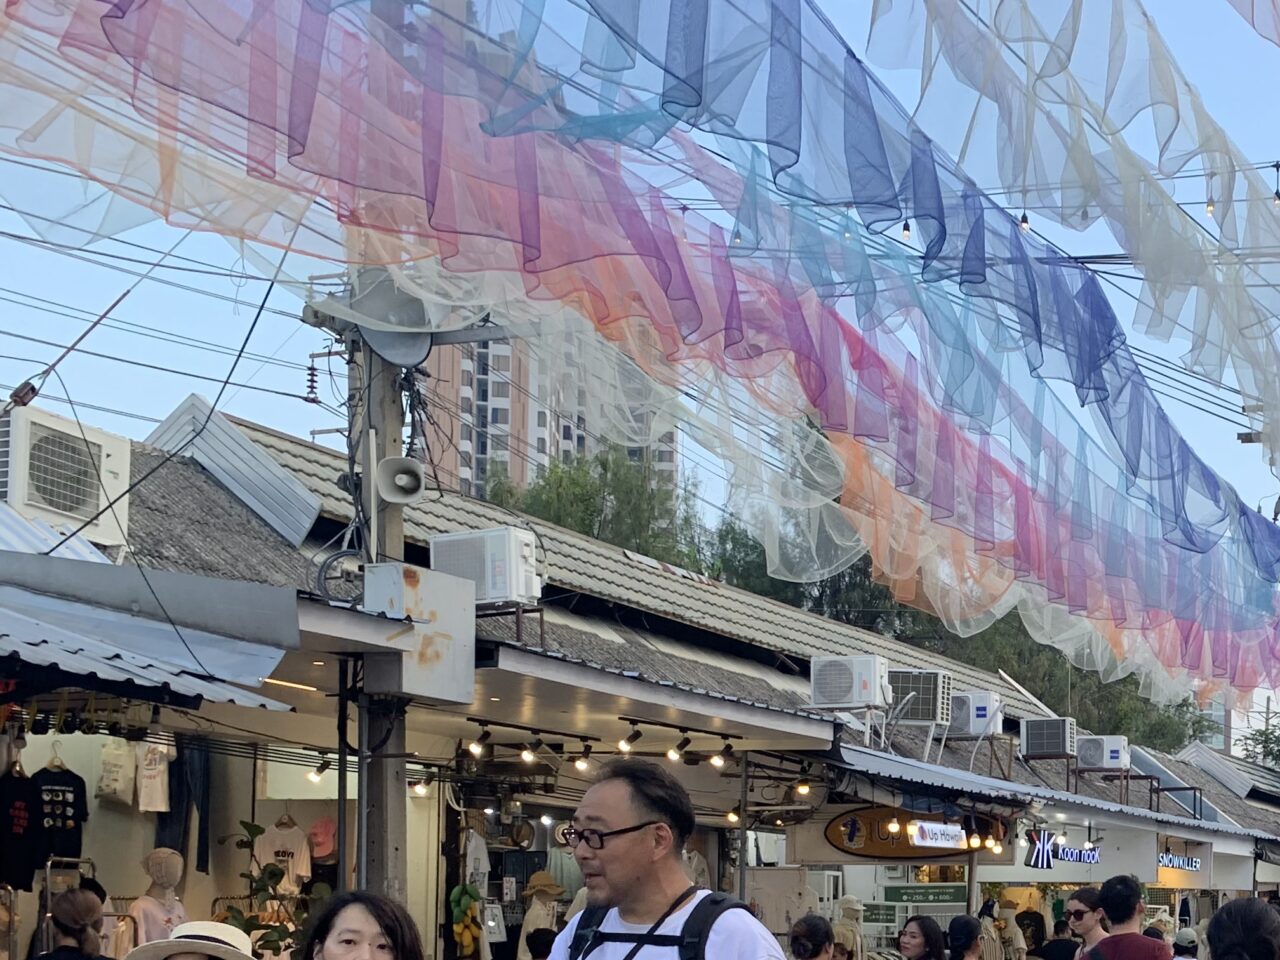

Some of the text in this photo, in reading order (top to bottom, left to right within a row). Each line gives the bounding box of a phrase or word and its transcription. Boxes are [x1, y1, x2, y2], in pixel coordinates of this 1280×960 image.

[927, 829, 939, 842] Up
[1058, 847, 1080, 862] Koon
[1158, 851, 1201, 872] SNOWKILLER
